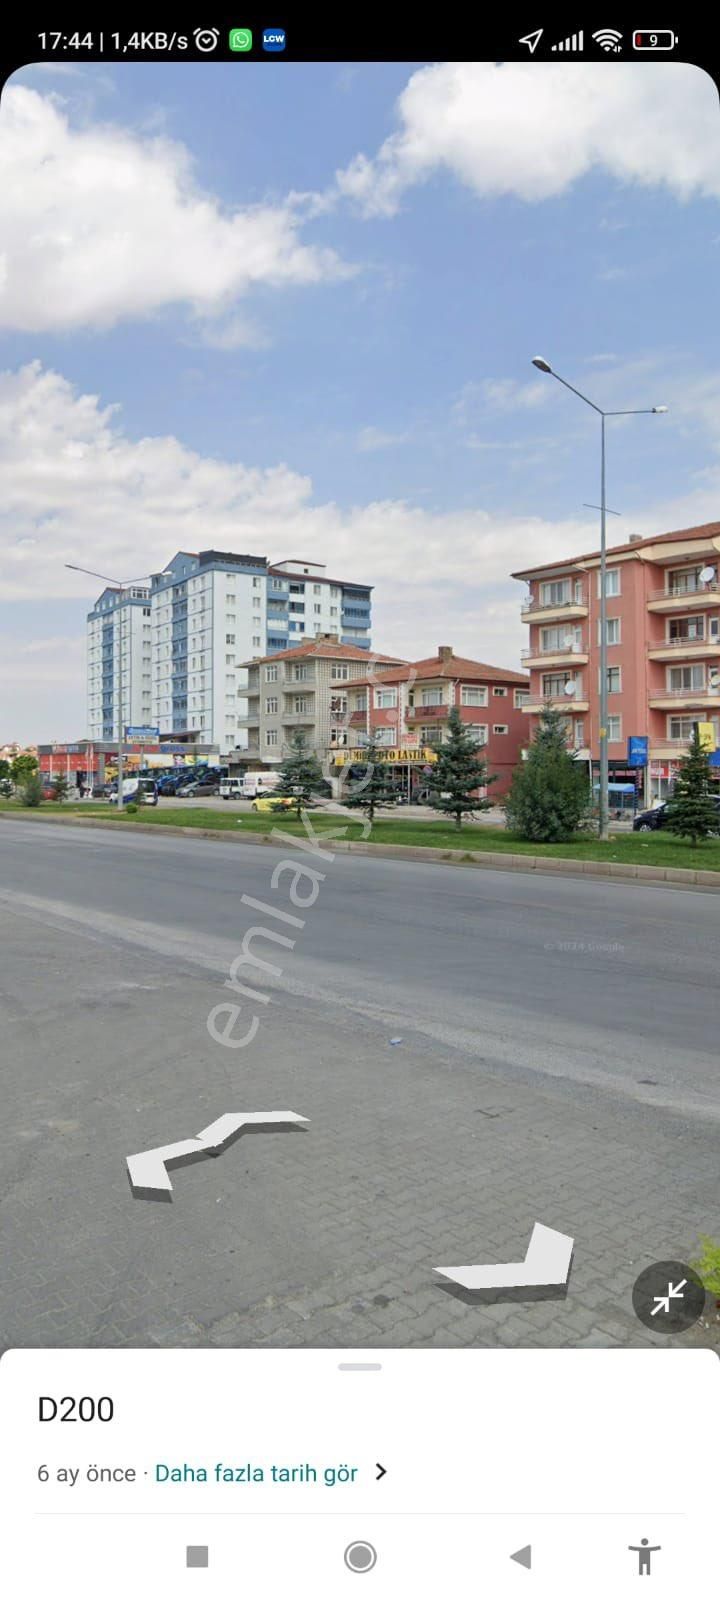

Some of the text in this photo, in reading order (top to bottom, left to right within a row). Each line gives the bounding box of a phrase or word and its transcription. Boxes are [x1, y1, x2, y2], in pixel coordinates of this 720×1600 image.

[37, 31, 189, 53] 17:44 1,4KB/s
[262, 34, 286, 44] LCW
[648, 34, 659, 47] 9
[38, 1396, 115, 1422] D200
[37, 1463, 358, 1486] 6 ay önce Daha fazla tarih gör
